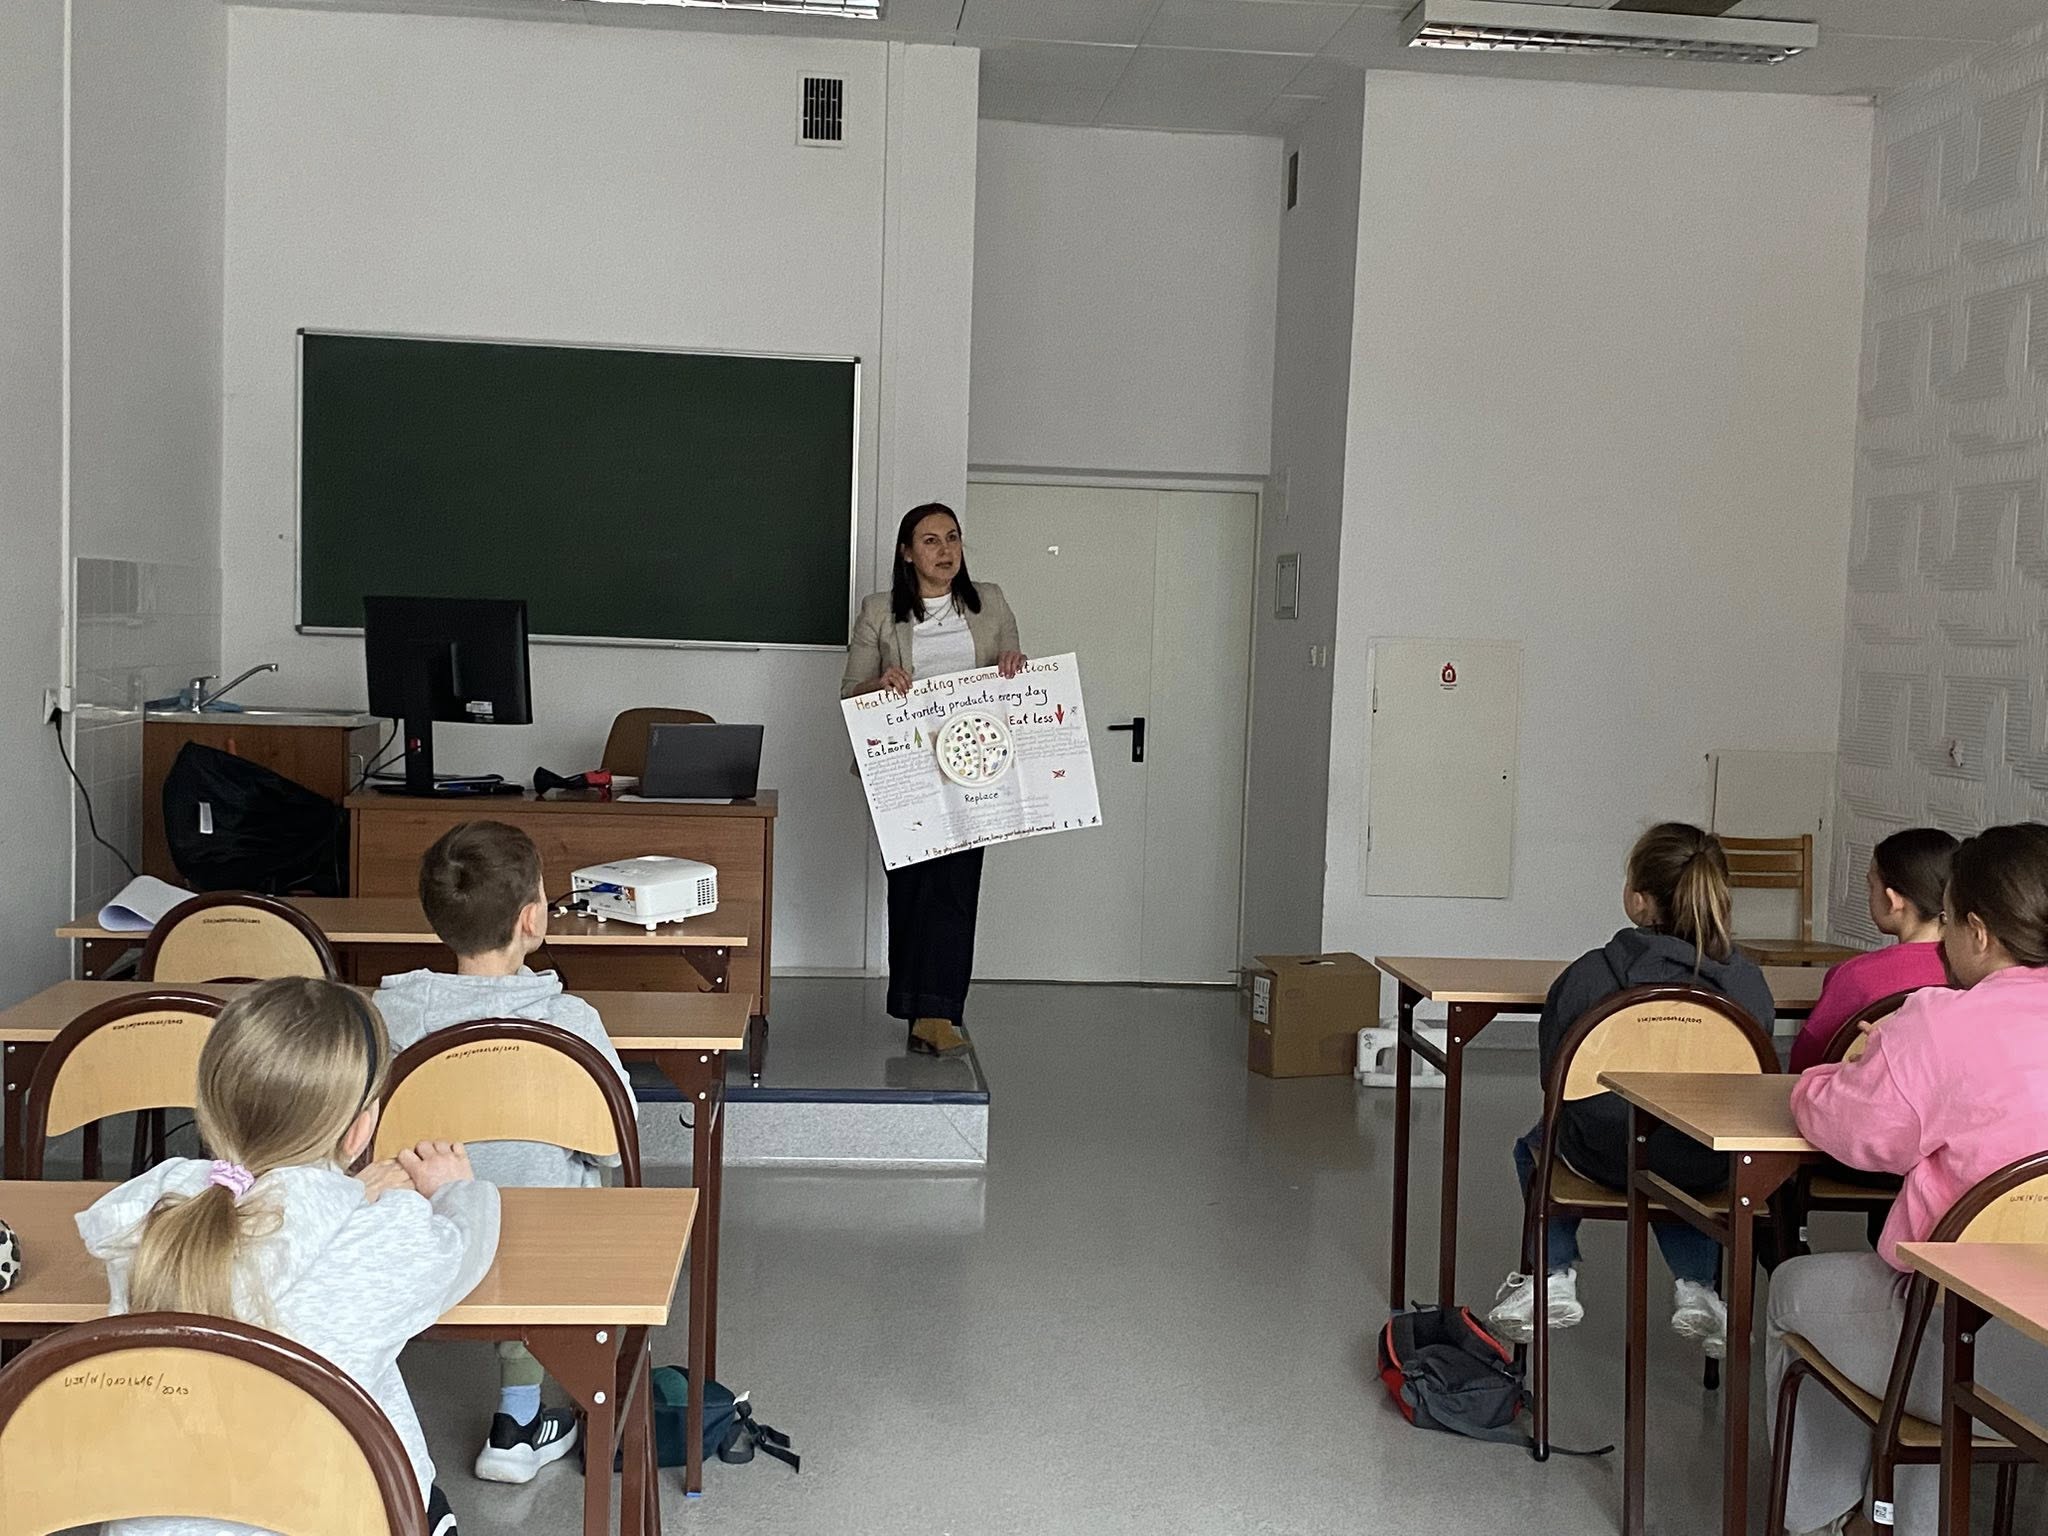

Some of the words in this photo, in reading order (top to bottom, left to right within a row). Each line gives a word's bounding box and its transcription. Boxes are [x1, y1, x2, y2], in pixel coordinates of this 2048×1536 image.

[913, 679, 955, 696] eating
[958, 662, 1059, 684] recommations
[886, 709, 910, 725] Eat
[911, 701, 946, 718] variety
[949, 690, 995, 714] products
[998, 692, 1022, 707] every
[1025, 685, 1048, 706] day
[1009, 713, 1028, 725] Eat
[1033, 712, 1054, 724] less
[888, 743, 911, 754] more
[964, 792, 999, 805] Replace
